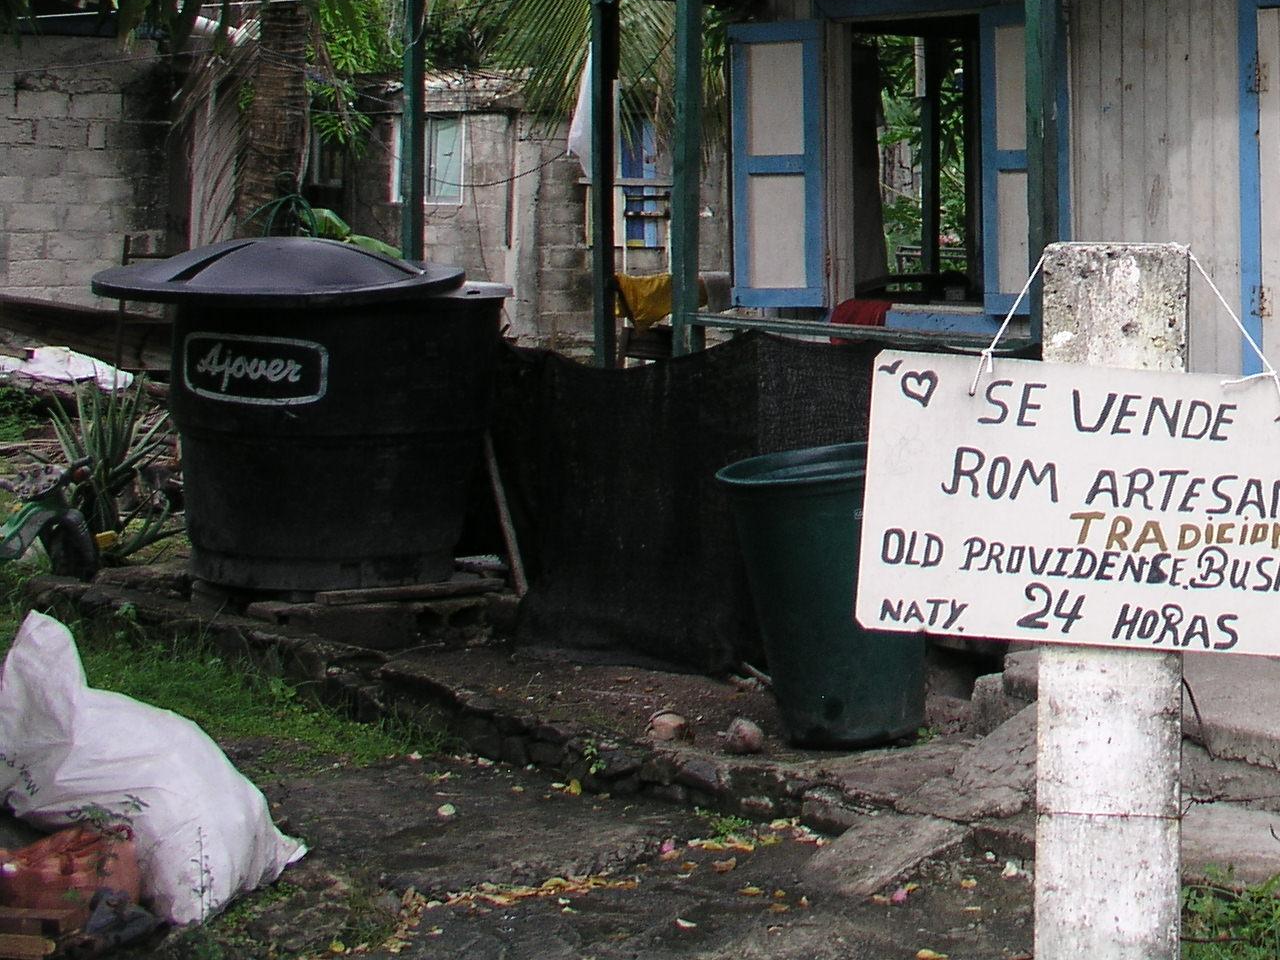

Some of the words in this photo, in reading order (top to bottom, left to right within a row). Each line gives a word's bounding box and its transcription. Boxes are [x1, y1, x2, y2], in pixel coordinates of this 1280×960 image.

[196, 341, 303, 391] Ajover
[977, 380, 1048, 428] SE
[1072, 389, 1237, 441] VENDE
[941, 446, 1058, 504] ROM
[880, 527, 944, 567] OLD
[879, 598, 969, 632] NATY.
[1016, 582, 1086, 634] 24
[1112, 603, 1240, 650] HORAS
